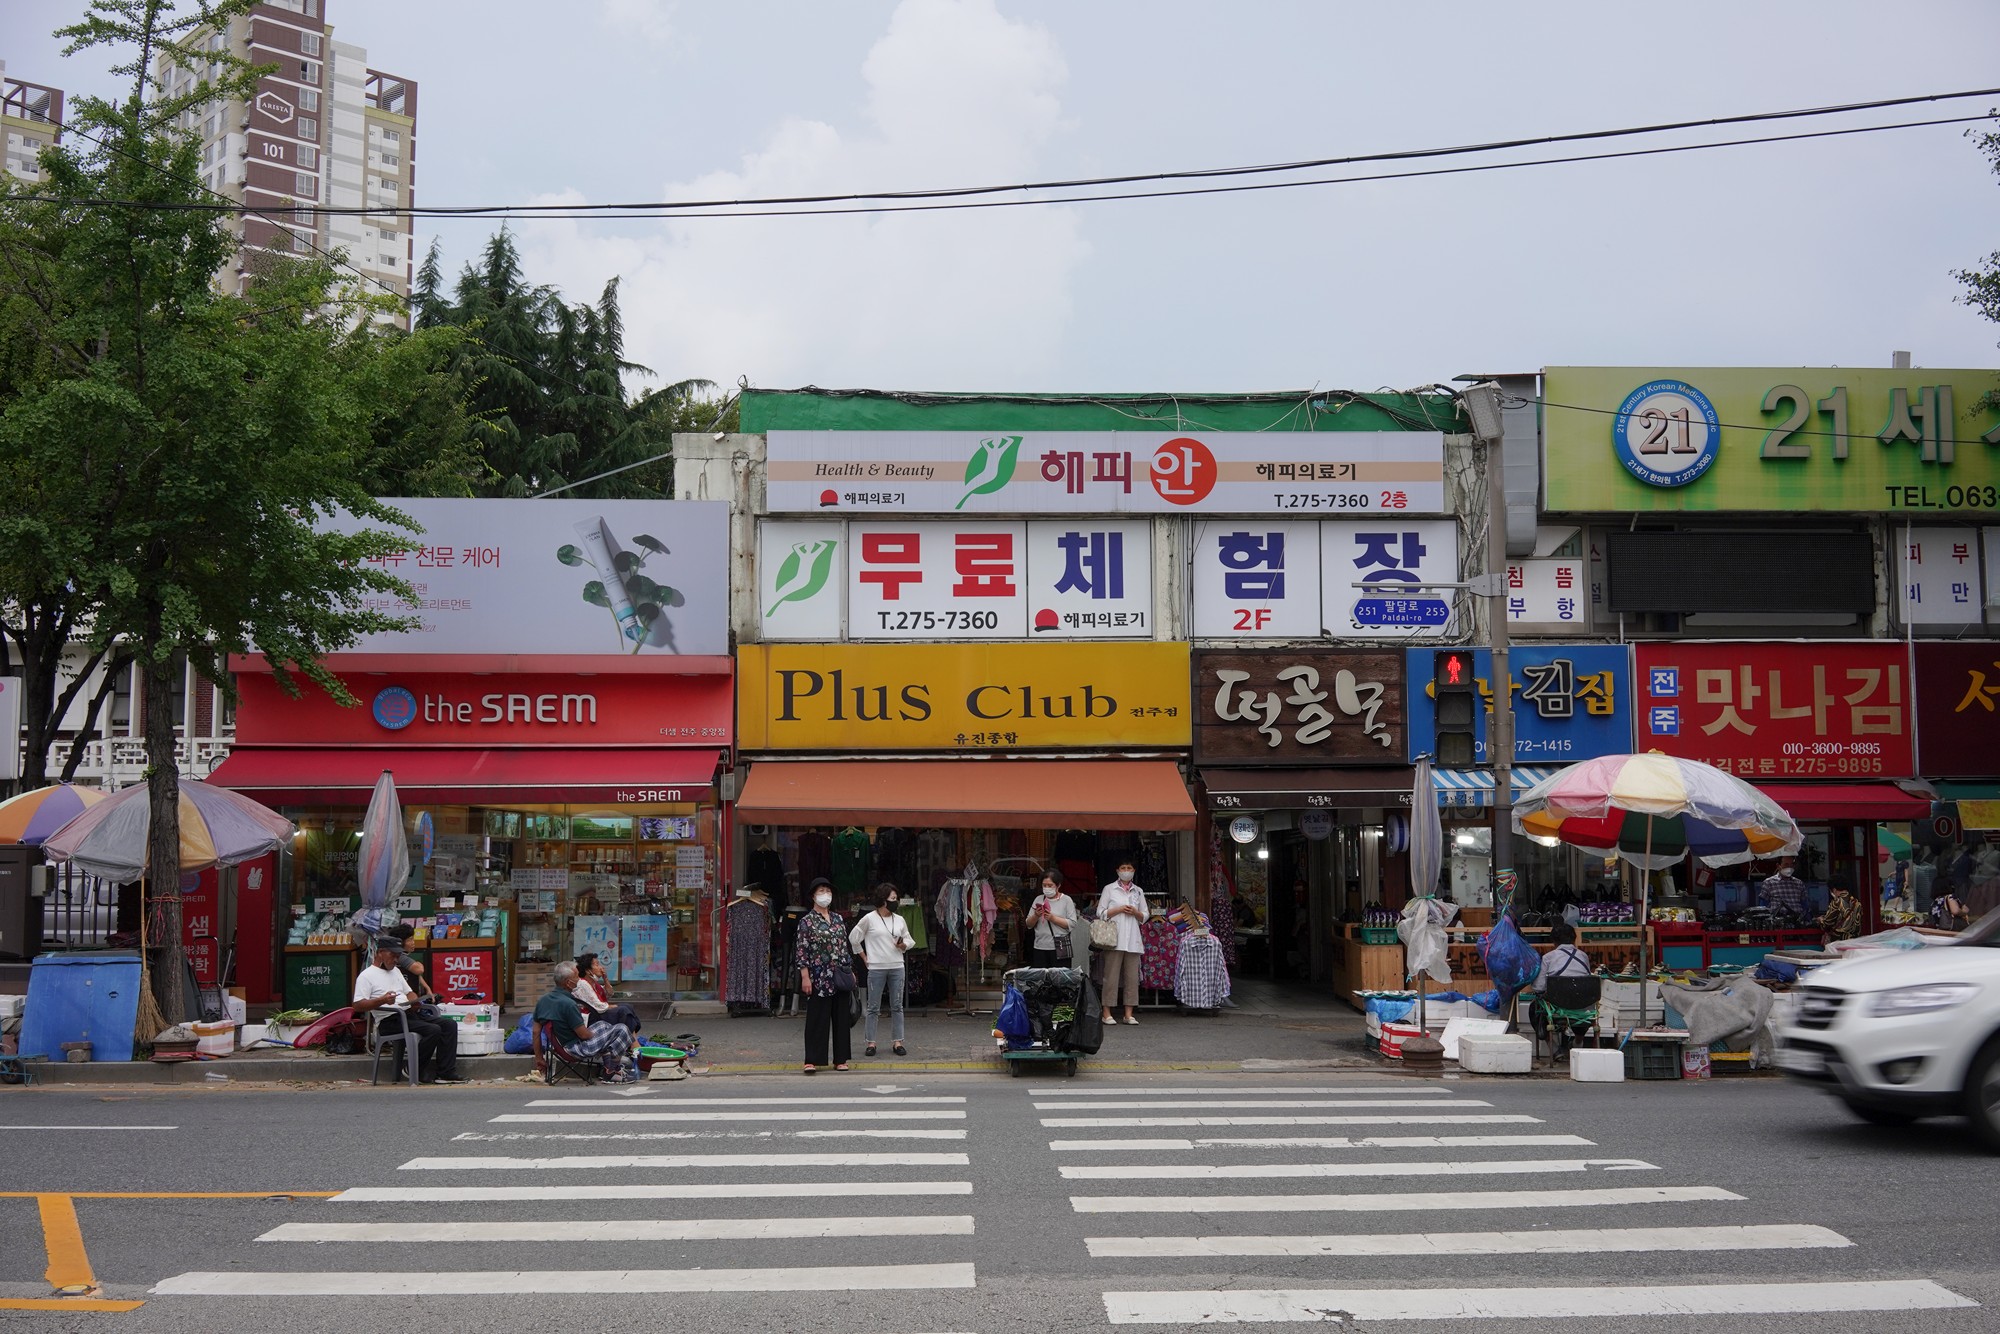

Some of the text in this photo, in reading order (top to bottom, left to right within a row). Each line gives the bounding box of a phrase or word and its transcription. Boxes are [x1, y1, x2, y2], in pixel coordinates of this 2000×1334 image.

[261, 101, 290, 114] ARISTA
[263, 143, 285, 160] 101
[1617, 415, 1626, 433] 21st
[1622, 390, 1646, 415] Century
[1647, 383, 1676, 393] Korean
[1677, 384, 1708, 410] Medicine
[1639, 407, 1697, 455] 21
[1760, 384, 2000, 463] 21세
[815, 462, 935, 481] Health & Beauty
[1256, 463, 1357, 481] 해피의료기
[1628, 453, 1712, 484] 21세기 한의원 T.273-3080
[844, 492, 905, 506] 해피의료기
[1274, 491, 1408, 509] T.275-7360 2층
[415, 546, 455, 568] 전문
[461, 546, 500, 568] 케어
[1555, 567, 1574, 589] 뜸
[1358, 600, 1445, 616] 251 팔달로 255
[877, 611, 998, 632] T.275-7360
[1063, 612, 1145, 629] 해피의료기
[1233, 608, 1272, 631] 2F
[1382, 614, 1422, 622] Paldal-ro
[775, 669, 1118, 722] Plus Club
[1695, 664, 1902, 736] 맛나김
[424, 693, 597, 723] the SAEM
[1129, 706, 1179, 718] 전주점
[659, 727, 726, 737] 더샘 전주 중앙점
[953, 732, 1019, 746] 유진종합
[1783, 742, 1881, 755] 010-3600-9895
[1780, 758, 1882, 774] T.275-9895
[617, 790, 681, 802] the SAEM
[395, 898, 412, 909] 1+1
[585, 927, 607, 941] 1+1
[444, 956, 480, 971] SALE
[447, 974, 478, 992] 50%
